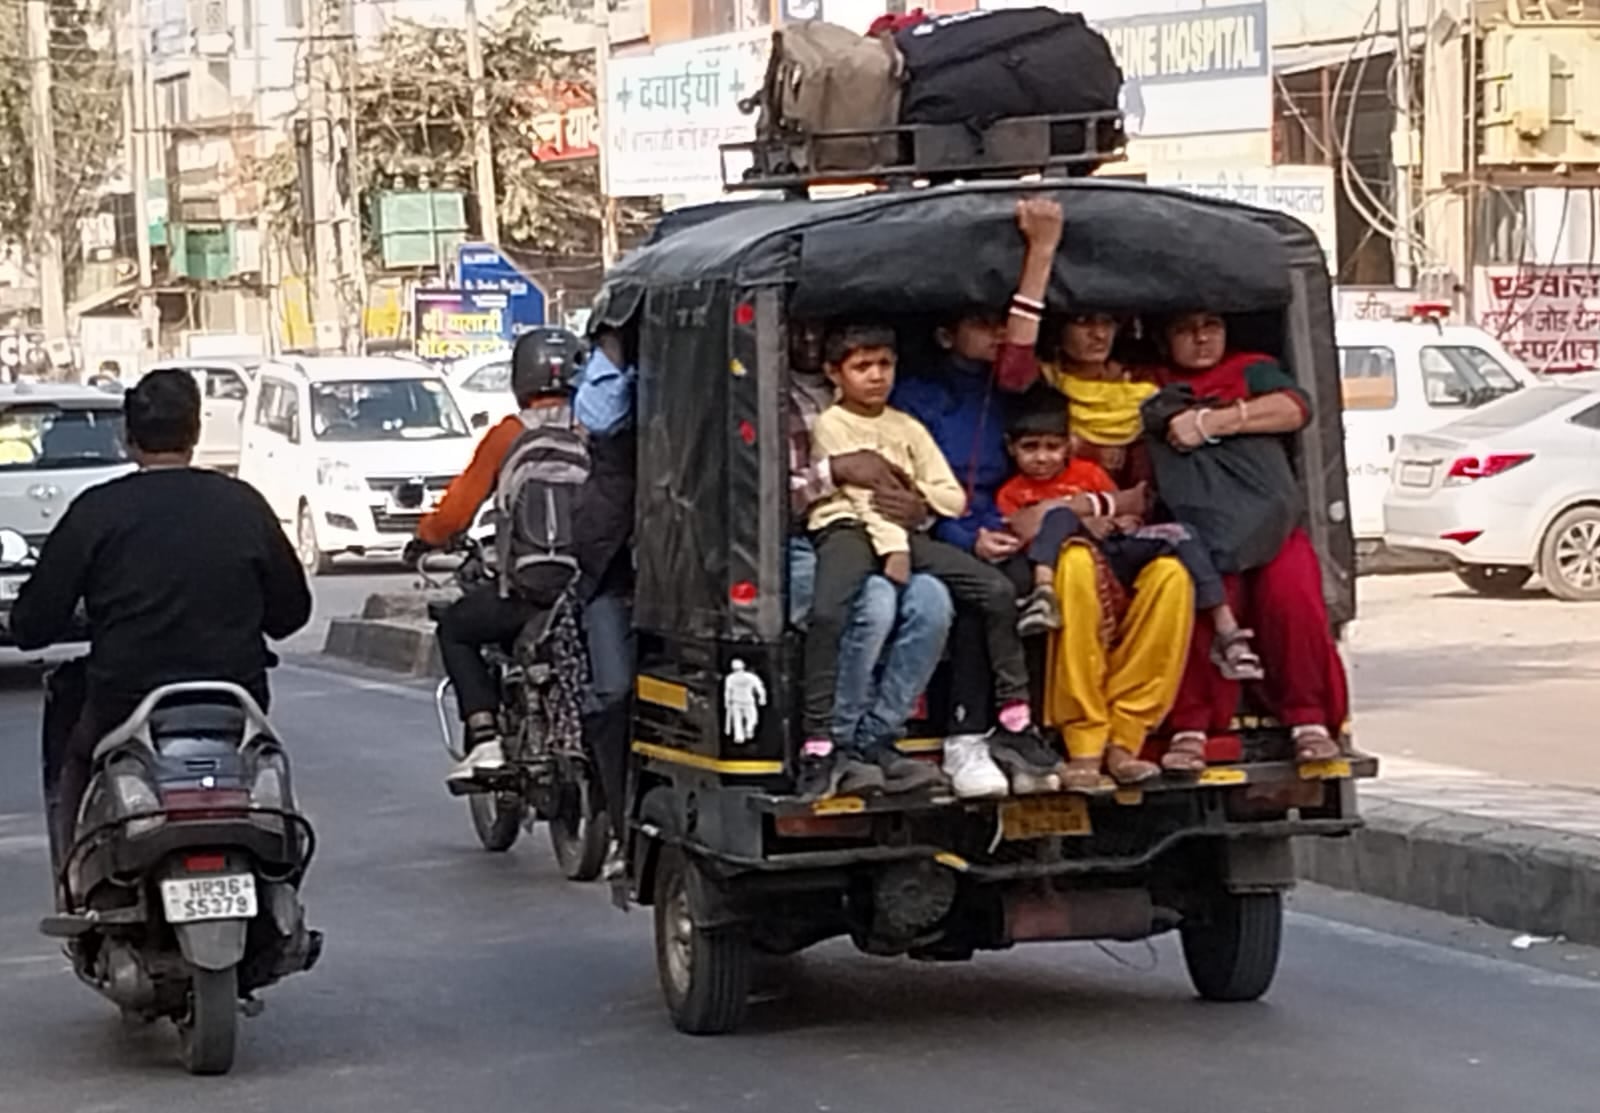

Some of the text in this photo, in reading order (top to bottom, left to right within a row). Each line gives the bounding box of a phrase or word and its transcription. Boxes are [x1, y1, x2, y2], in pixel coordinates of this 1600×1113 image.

[1103, 16, 1261, 81] CINE HOSPITAL
[638, 59, 721, 115] दवाईयाँ
[188, 878, 241, 898] HR36
